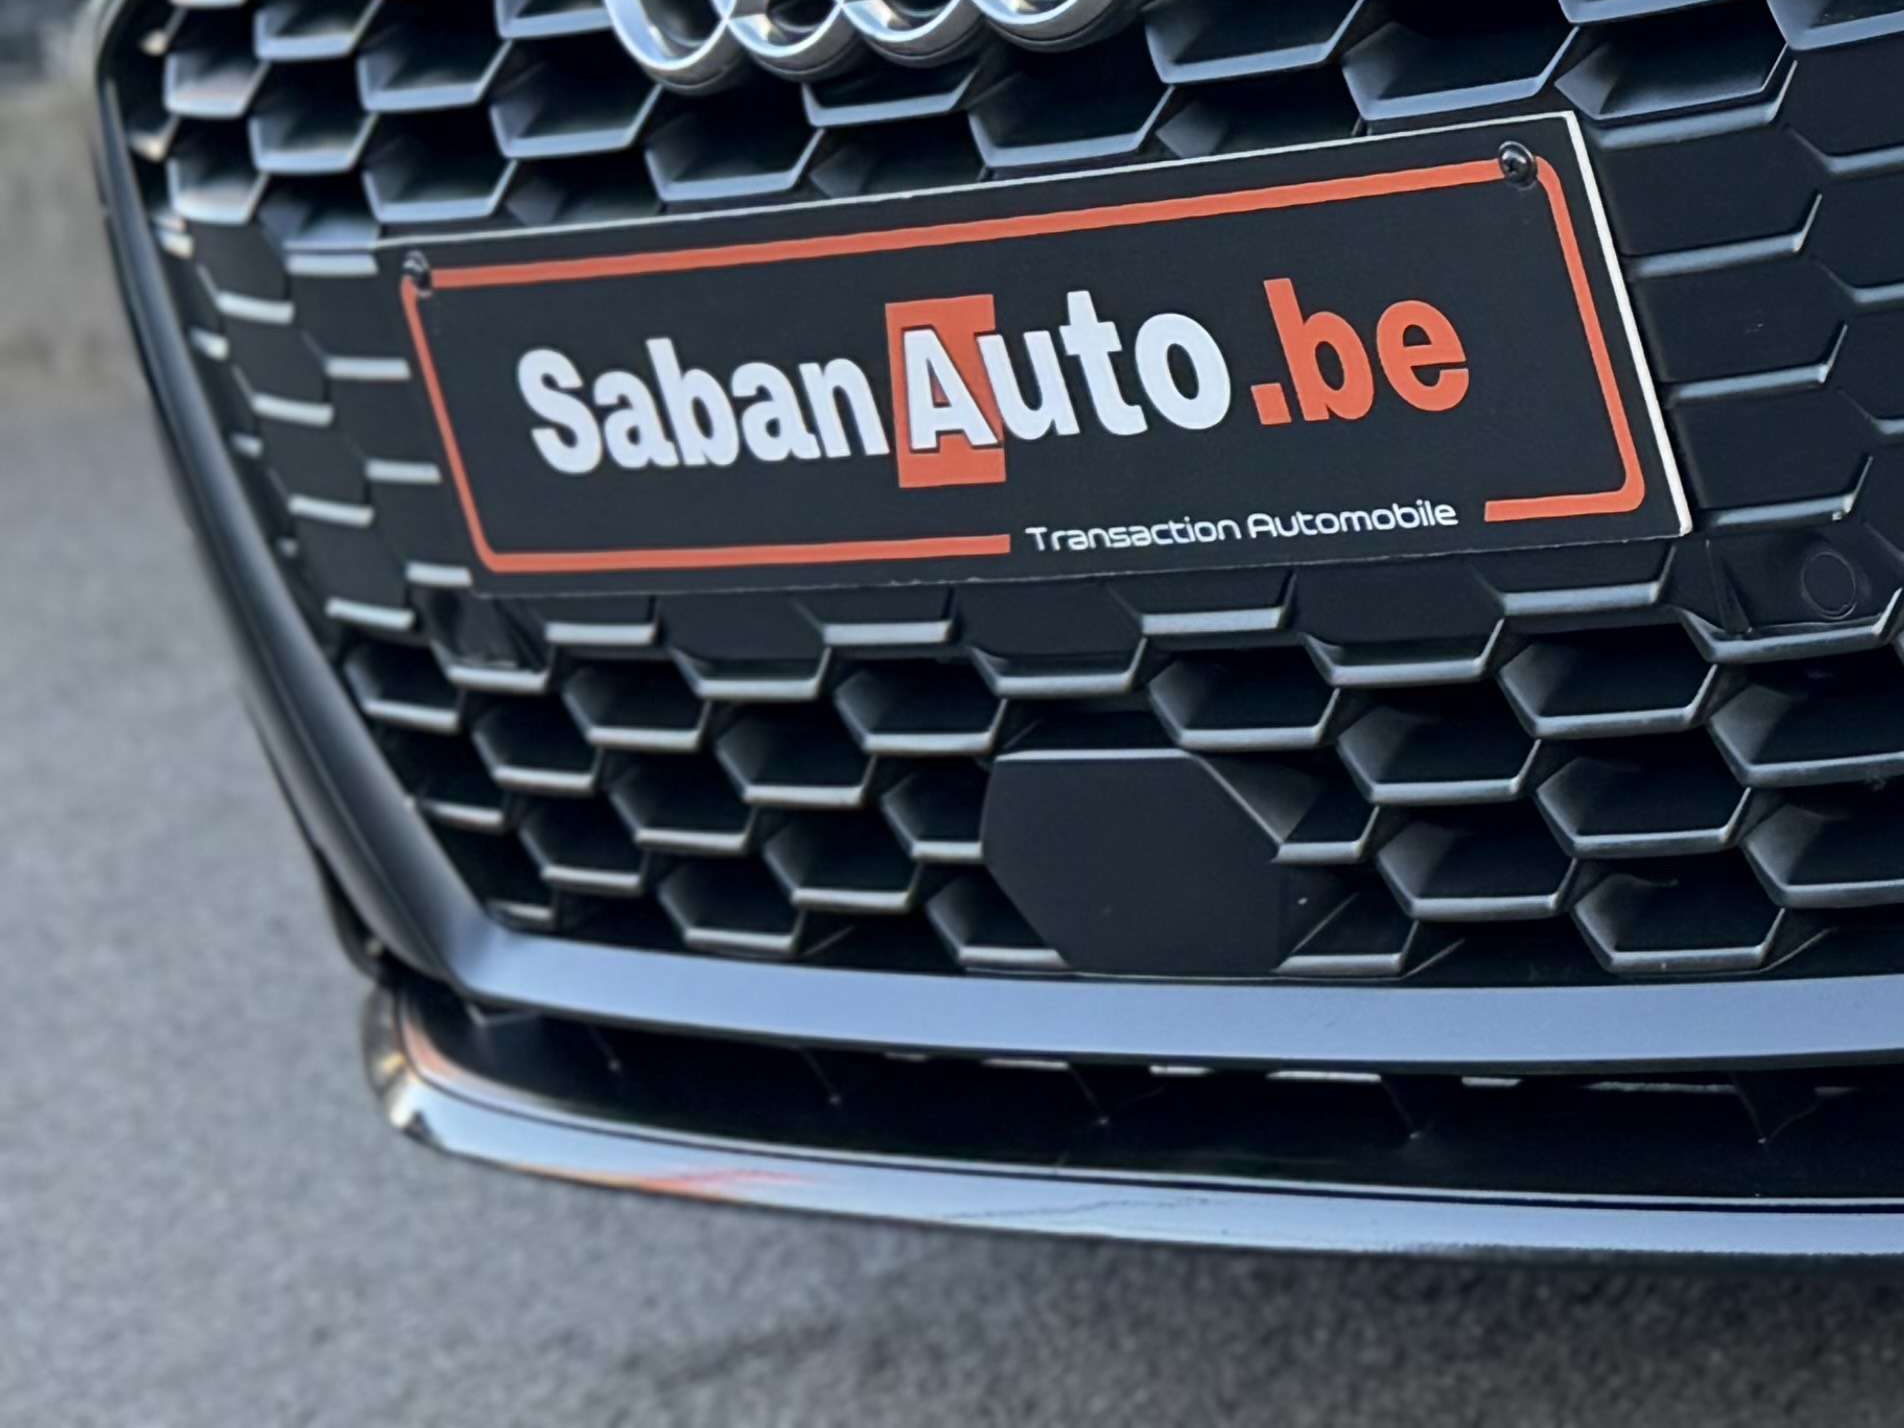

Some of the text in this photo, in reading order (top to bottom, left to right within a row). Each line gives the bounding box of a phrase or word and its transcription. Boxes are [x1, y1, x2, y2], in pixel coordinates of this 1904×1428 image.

[516, 277, 1470, 475] SabanAuto.be
[1025, 499, 1459, 551] Transaction Automobile
